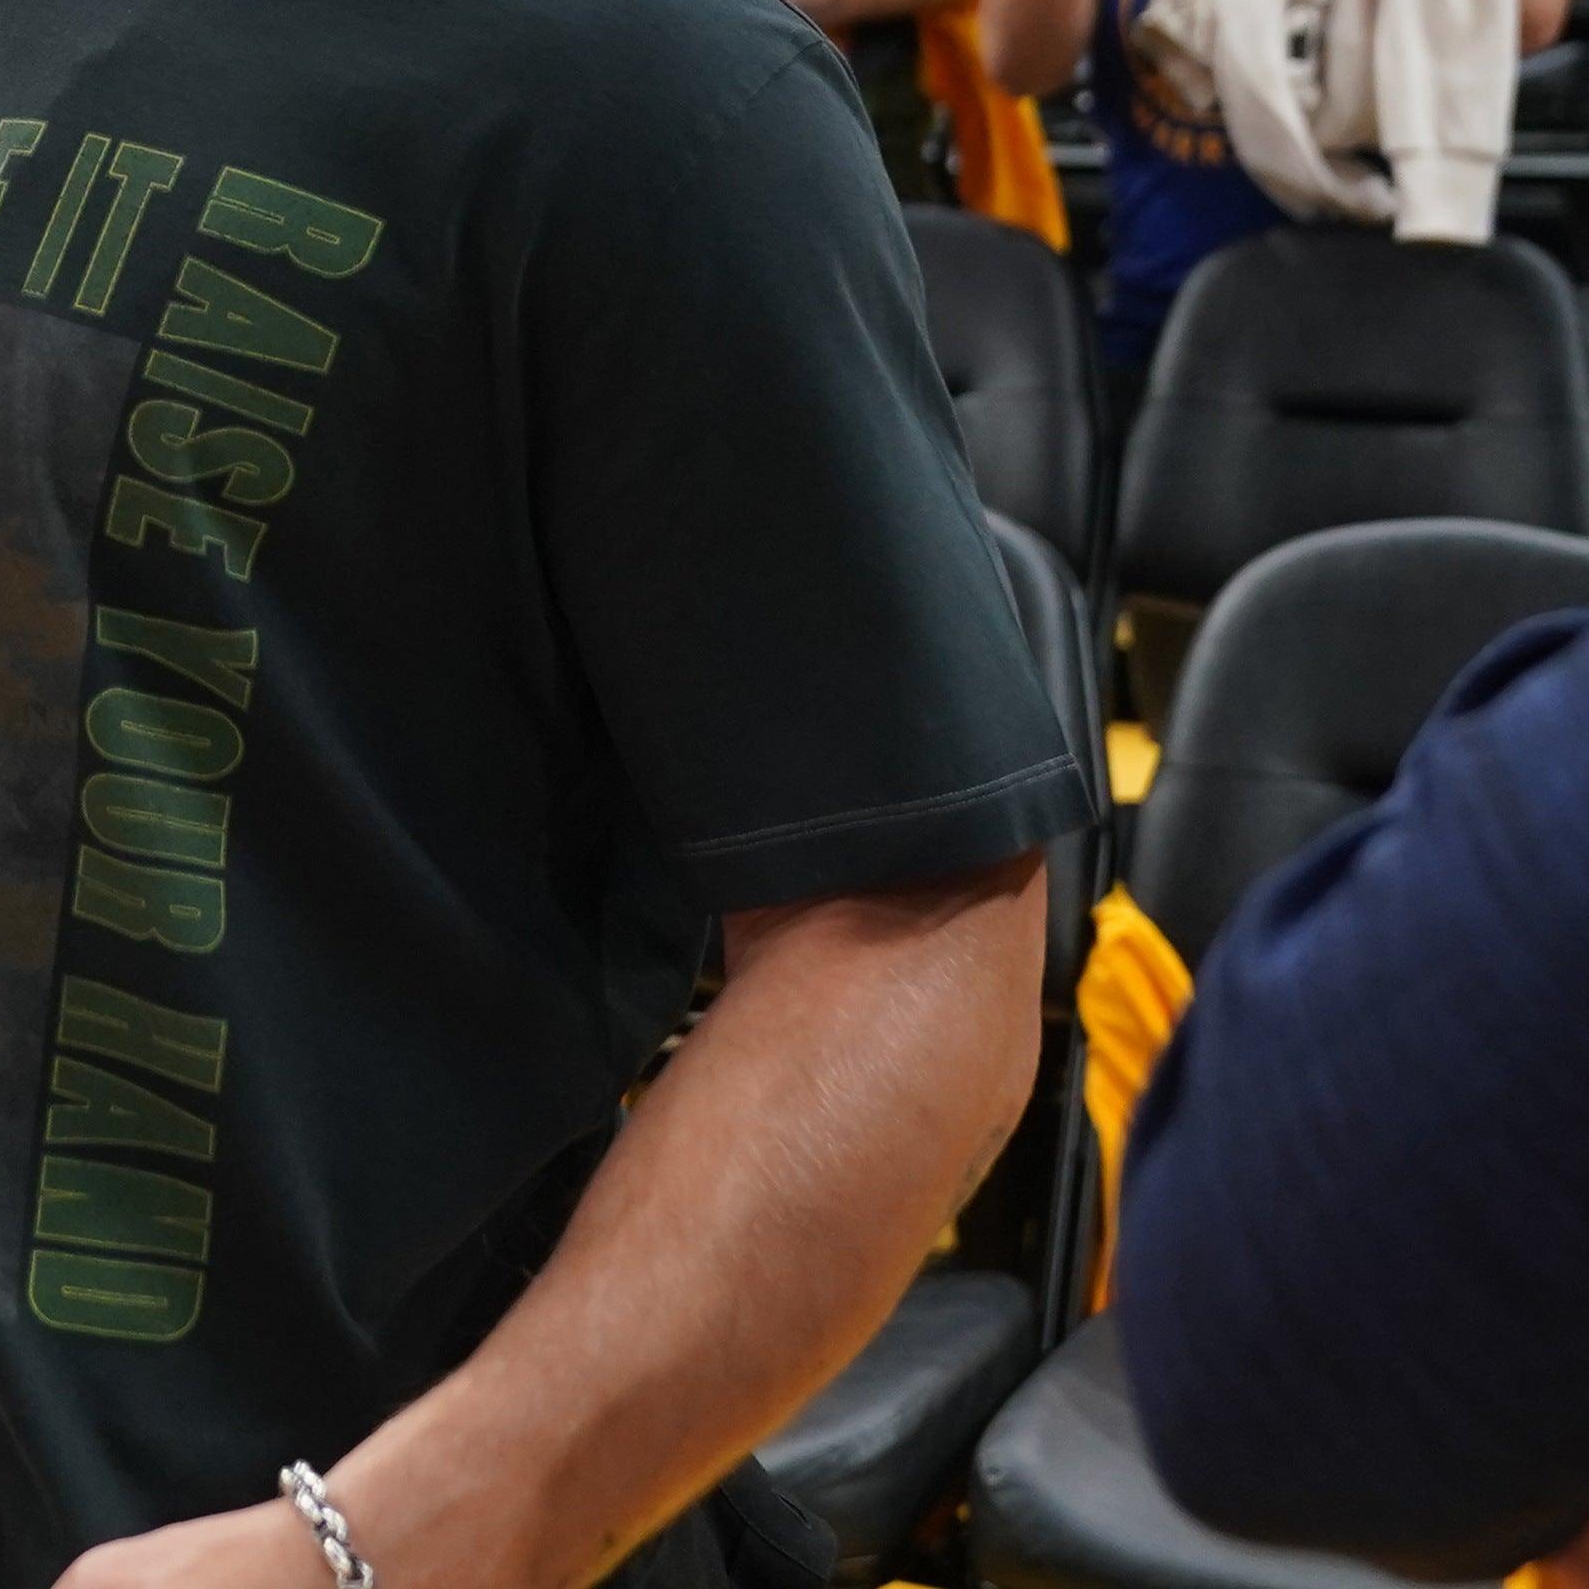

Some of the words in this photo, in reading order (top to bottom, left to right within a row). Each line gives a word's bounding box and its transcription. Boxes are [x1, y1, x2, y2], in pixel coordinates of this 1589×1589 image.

[21, 131, 185, 318] IT
[104, 165, 387, 585] RAISE
[71, 603, 260, 955] YOUR
[27, 972, 228, 1344] HAND
